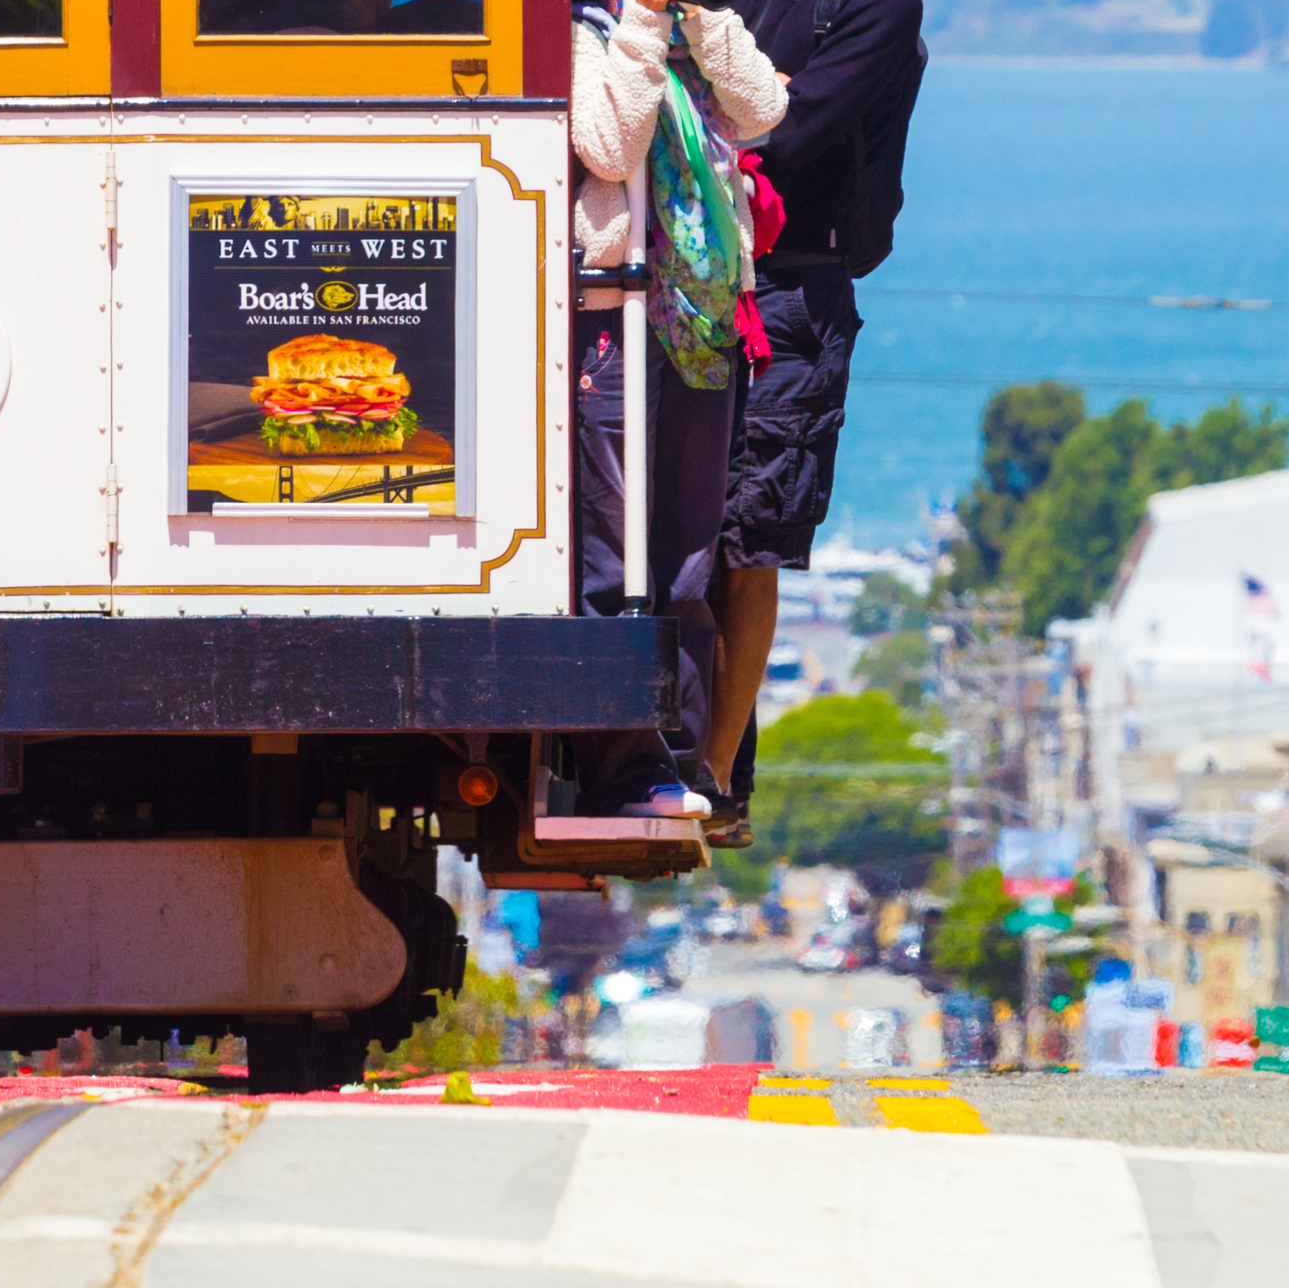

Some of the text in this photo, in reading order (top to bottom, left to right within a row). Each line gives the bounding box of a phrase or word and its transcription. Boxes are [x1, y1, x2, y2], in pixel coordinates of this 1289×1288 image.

[218, 238, 449, 259] EAST MEETS WEST
[237, 282, 428, 311] Boar's Head
[246, 315, 421, 325] AVAILABLE IN SAN FRANCISCO
